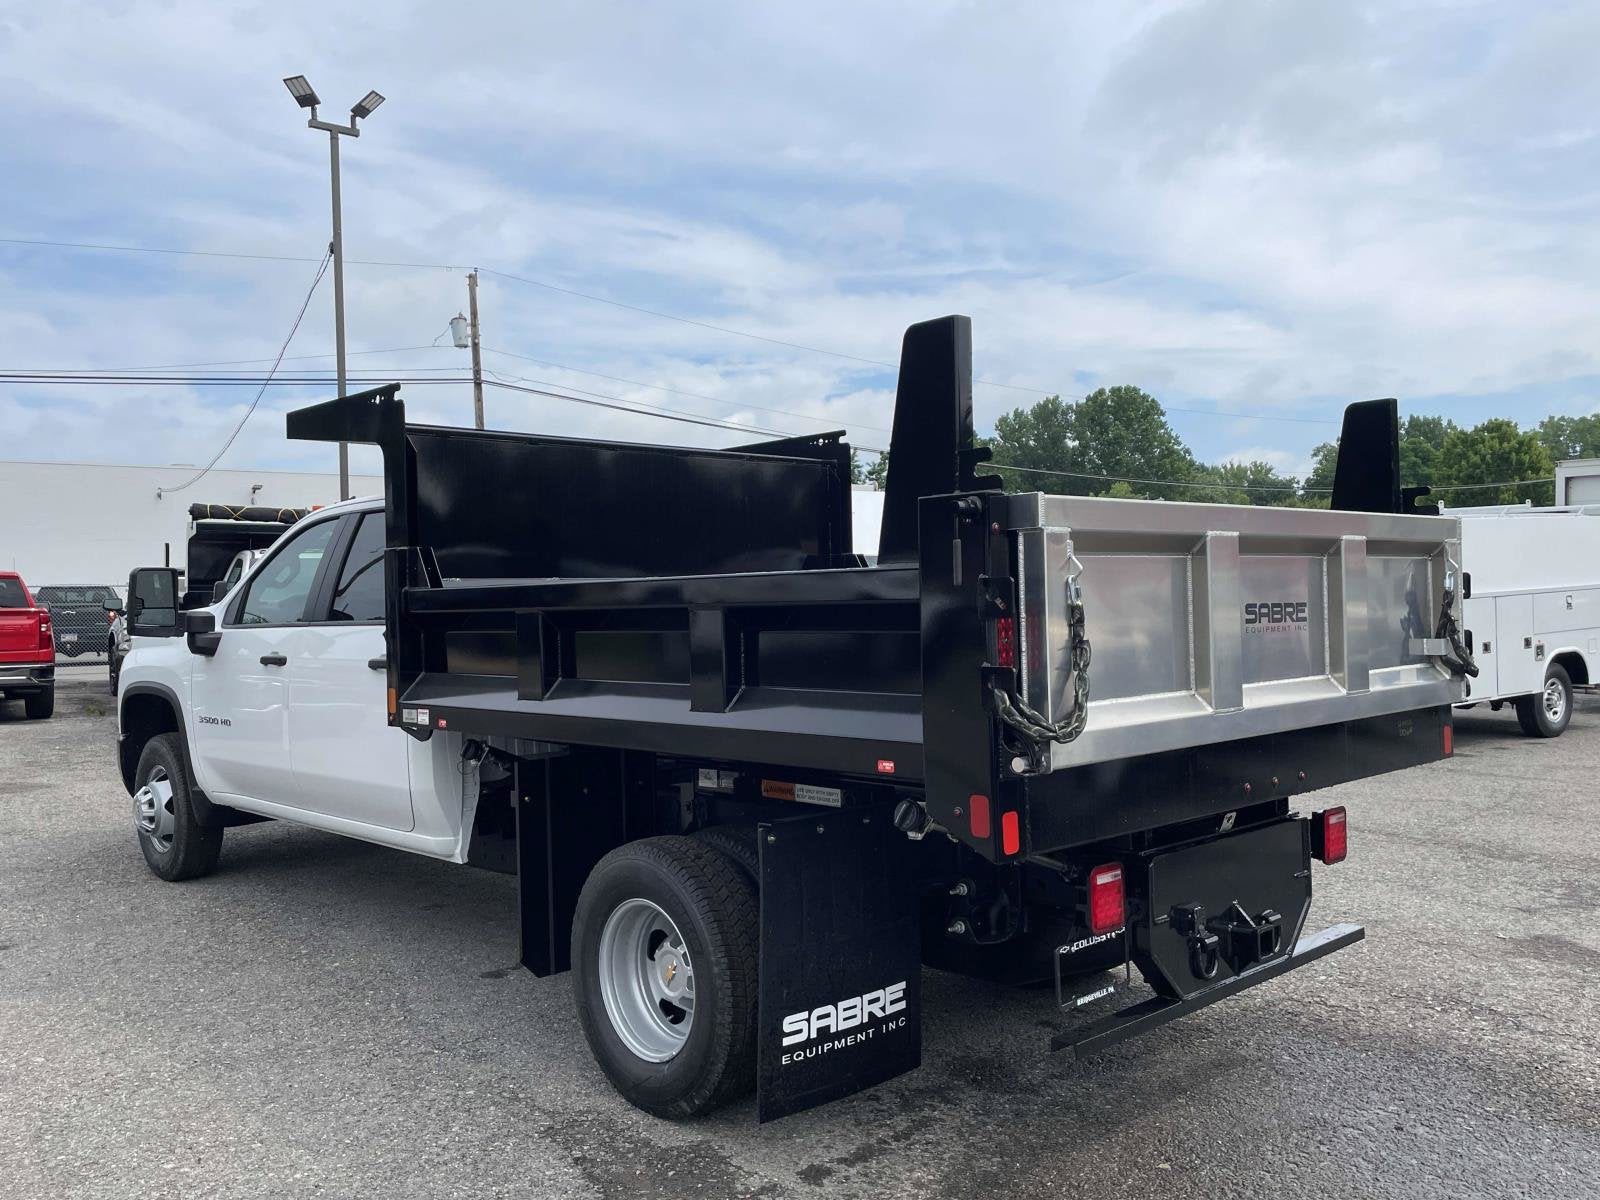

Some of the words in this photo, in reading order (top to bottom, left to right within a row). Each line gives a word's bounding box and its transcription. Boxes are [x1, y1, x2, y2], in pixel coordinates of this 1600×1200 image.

[1245, 602, 1307, 624] SABRE
[1245, 625, 1291, 633] EQUIPMENT
[199, 716, 219, 725] 3500
[220, 718, 231, 726] HD
[782, 981, 907, 1047] SABRE
[782, 1029, 875, 1065] EQUIPMENT
[882, 1017, 907, 1034] INC
